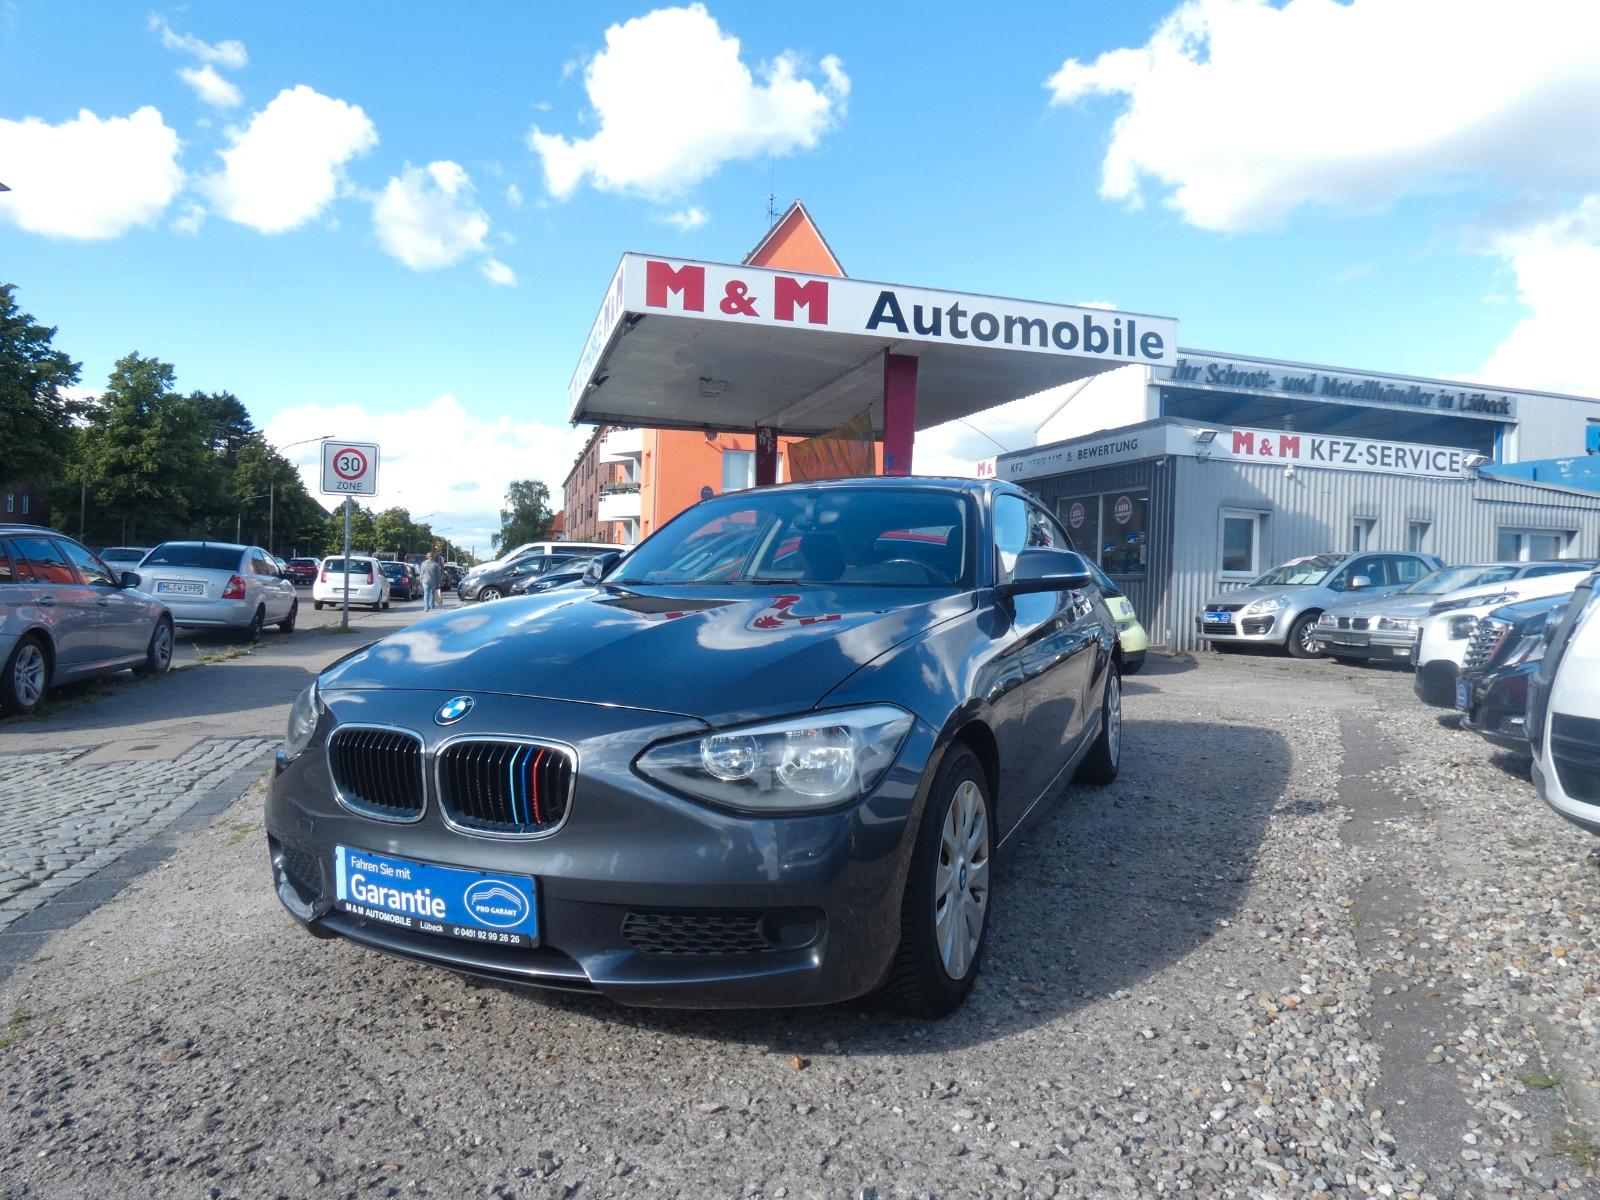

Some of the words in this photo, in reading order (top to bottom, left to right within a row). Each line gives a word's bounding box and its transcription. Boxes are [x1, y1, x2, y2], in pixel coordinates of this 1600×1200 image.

[645, 260, 706, 313] M
[719, 279, 761, 318] &
[774, 275, 829, 325] M
[865, 290, 1165, 360] Automobile
[1205, 362, 1277, 389] Schrott-
[1458, 392, 1512, 415] Lübeck
[340, 456, 360, 472] 30
[1010, 462, 1023, 472] KFZ
[1066, 451, 1073, 463] &
[1077, 438, 1138, 460] BEWERTUNG
[1232, 430, 1255, 456] M
[1258, 438, 1274, 457] &
[1279, 434, 1301, 459] M
[1310, 438, 1461, 473] KFZ-SERVICE
[336, 481, 363, 491] ZONE
[351, 856, 379, 873] Fahren
[380, 862, 394, 877] Sie
[395, 866, 411, 880] mit
[351, 873, 446, 919] Garantie
[476, 904, 490, 914] PRO
[490, 907, 517, 917] GARANT
[345, 902, 352, 911] M
[352, 905, 359, 914] &
[358, 907, 364, 916] M
[365, 908, 412, 927] AUTOMOBILE
[420, 920, 444, 933] Lübeck
[460, 927, 476, 938] 0451
[477, 930, 487, 940] 92
[488, 932, 498, 942] 99
[499, 934, 509, 943] 26
[510, 934, 520, 944] 26
